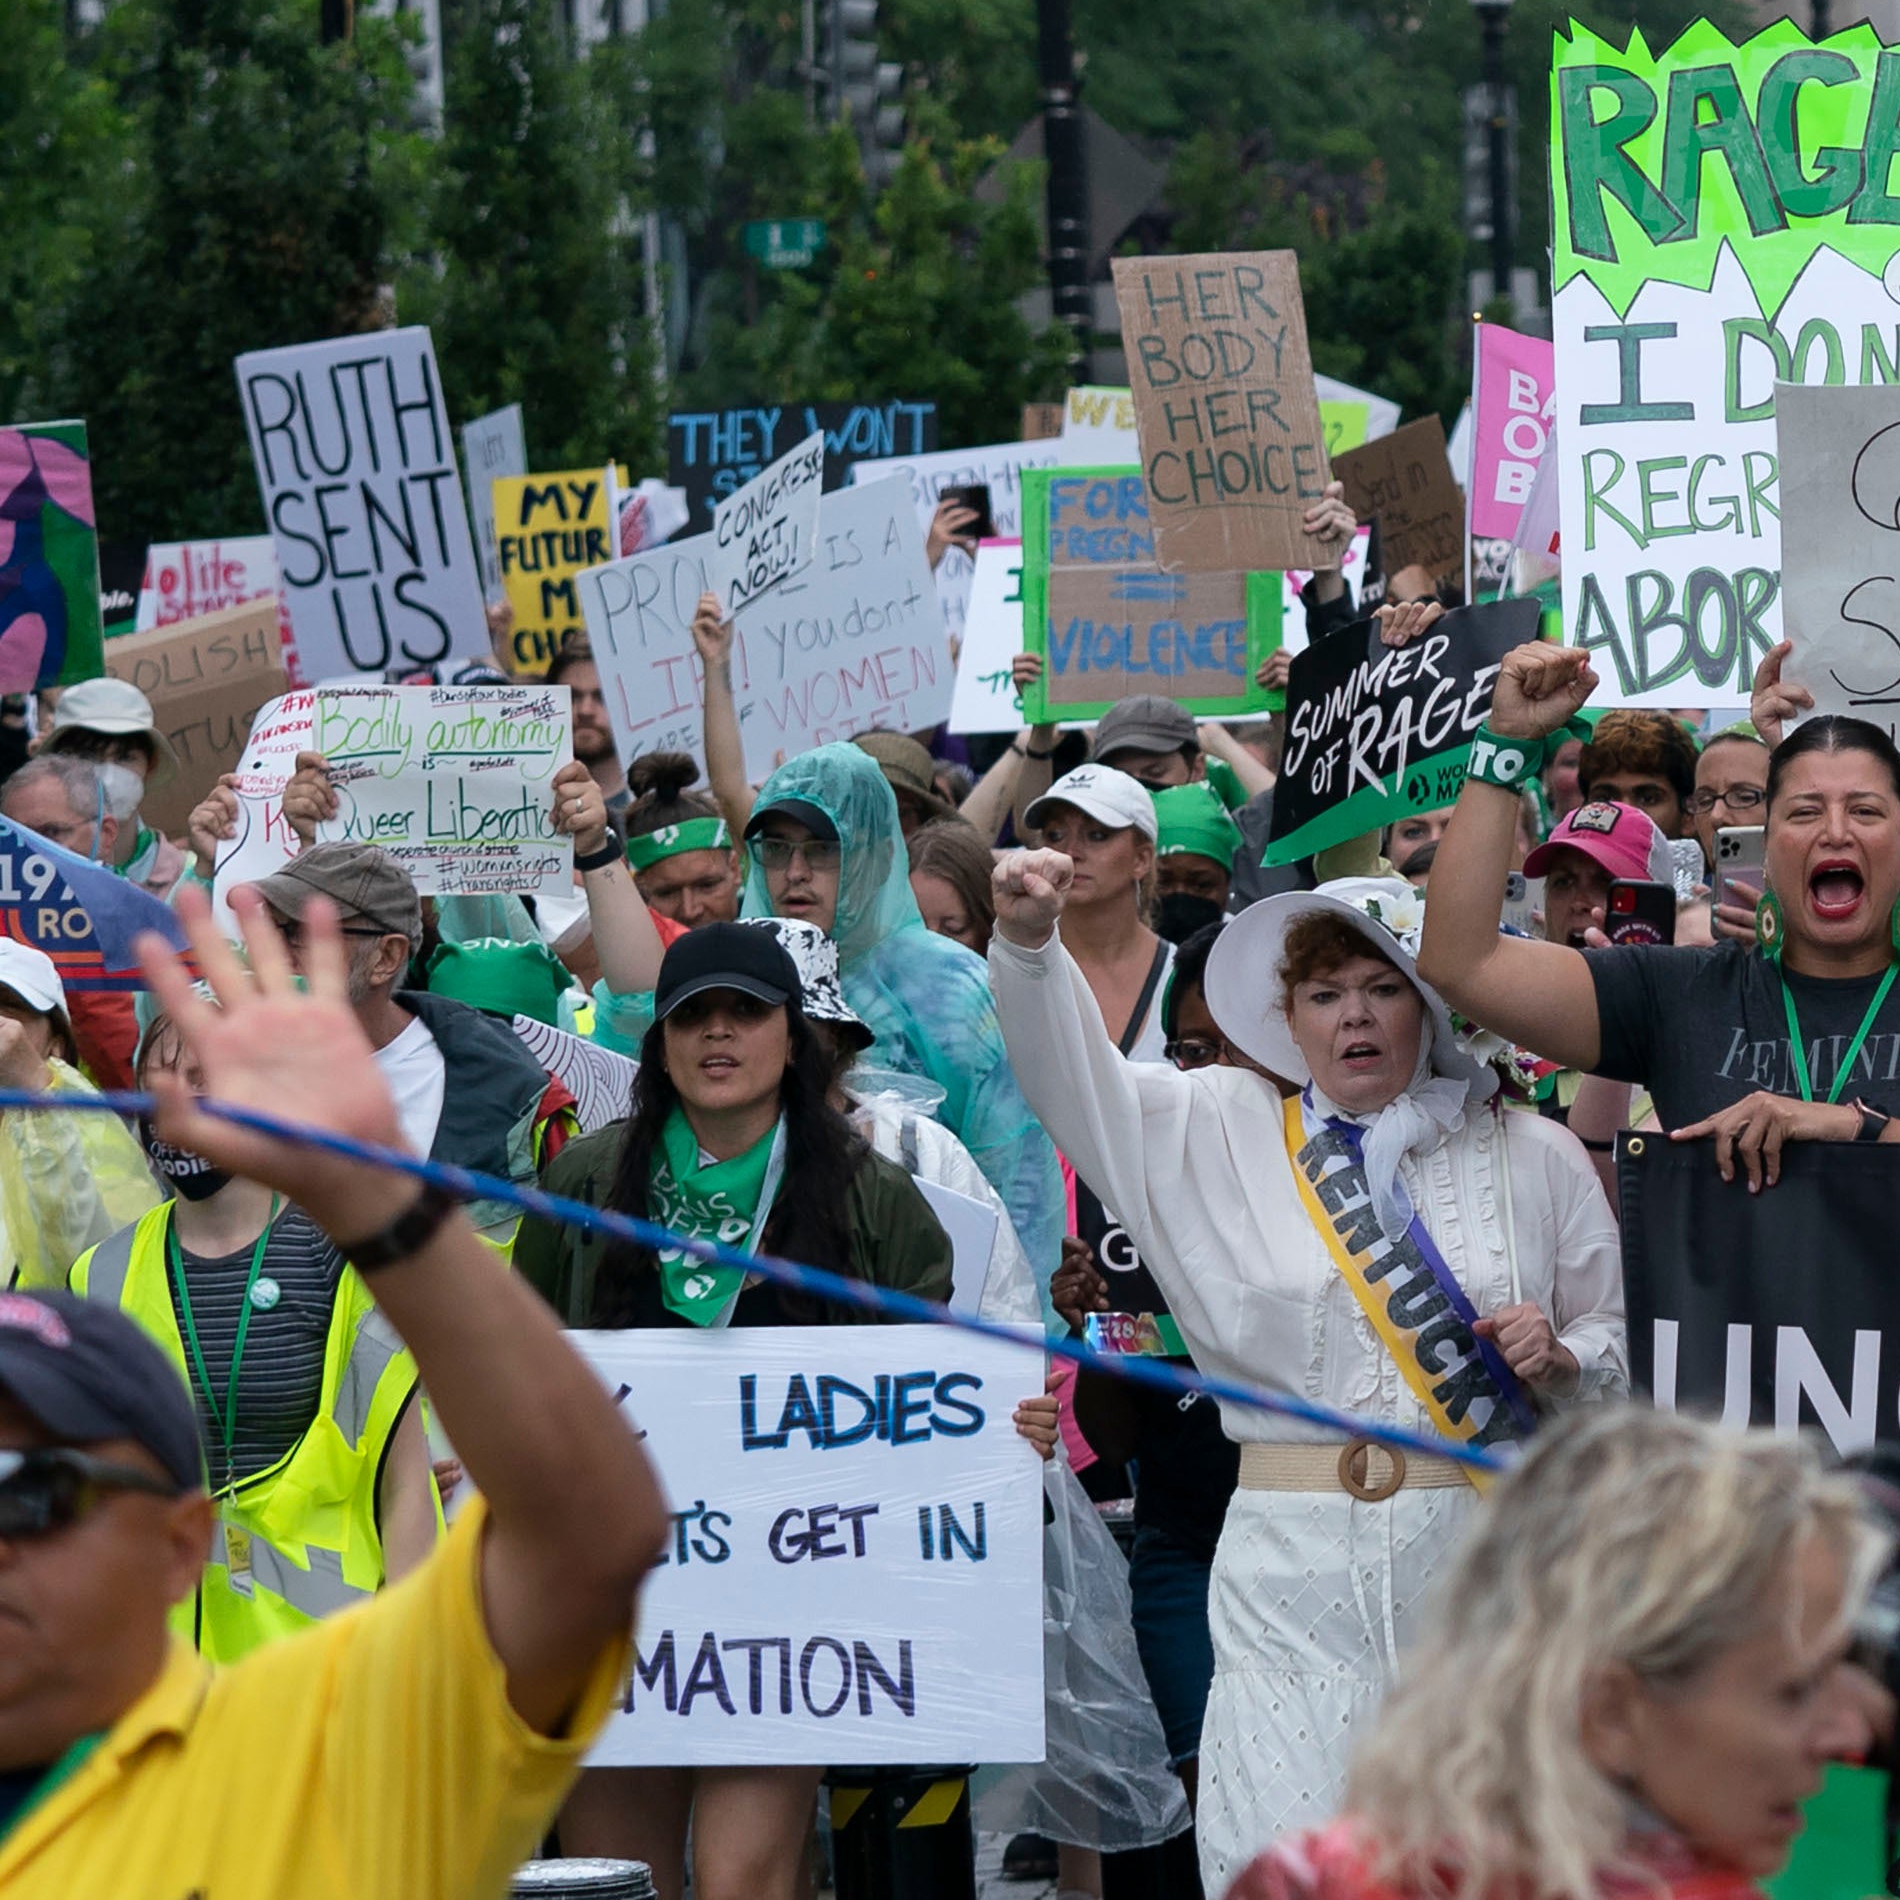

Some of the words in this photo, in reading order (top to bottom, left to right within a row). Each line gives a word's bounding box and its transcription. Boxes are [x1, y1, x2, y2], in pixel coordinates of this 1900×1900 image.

[1143, 265, 1280, 322] HER
[1138, 326, 1289, 388] BODY
[1580, 322, 1695, 426] I
[1723, 317, 1846, 423] DO
[248, 351, 444, 486] RUTH
[671, 406, 782, 467] THEY
[805, 400, 935, 456] WON'T
[1164, 388, 1290, 443] HER
[520, 480, 598, 528] MY
[1049, 476, 1149, 522] FOR
[1149, 442, 1324, 504] CHOICE
[1581, 447, 1782, 551] REGR
[272, 468, 454, 588] SENT
[500, 525, 612, 576] FUTUR
[746, 515, 789, 569] ACT
[826, 529, 865, 572] IS
[882, 515, 901, 557] A
[1050, 525, 1155, 564] PREGN
[157, 544, 248, 603] olite
[727, 523, 799, 608] NOW!
[331, 570, 453, 673] US
[1049, 615, 1249, 678] VIOLENCE
[1572, 566, 1783, 698] ABOR
[106, 628, 269, 694] OLISH
[764, 645, 937, 733] WOMEN
[319, 695, 412, 780] Bodily
[427, 702, 565, 781] autonomy
[1284, 634, 1450, 778] SUMMER
[1347, 662, 1502, 798] RAGE
[1311, 738, 1343, 795] OF
[320, 784, 416, 847] Queer
[427, 776, 570, 839] Liberatio
[739, 1369, 986, 1452] LADIES
[768, 1502, 880, 1563] GET
[918, 1501, 988, 1563] IN
[620, 1629, 916, 1719] MATION
